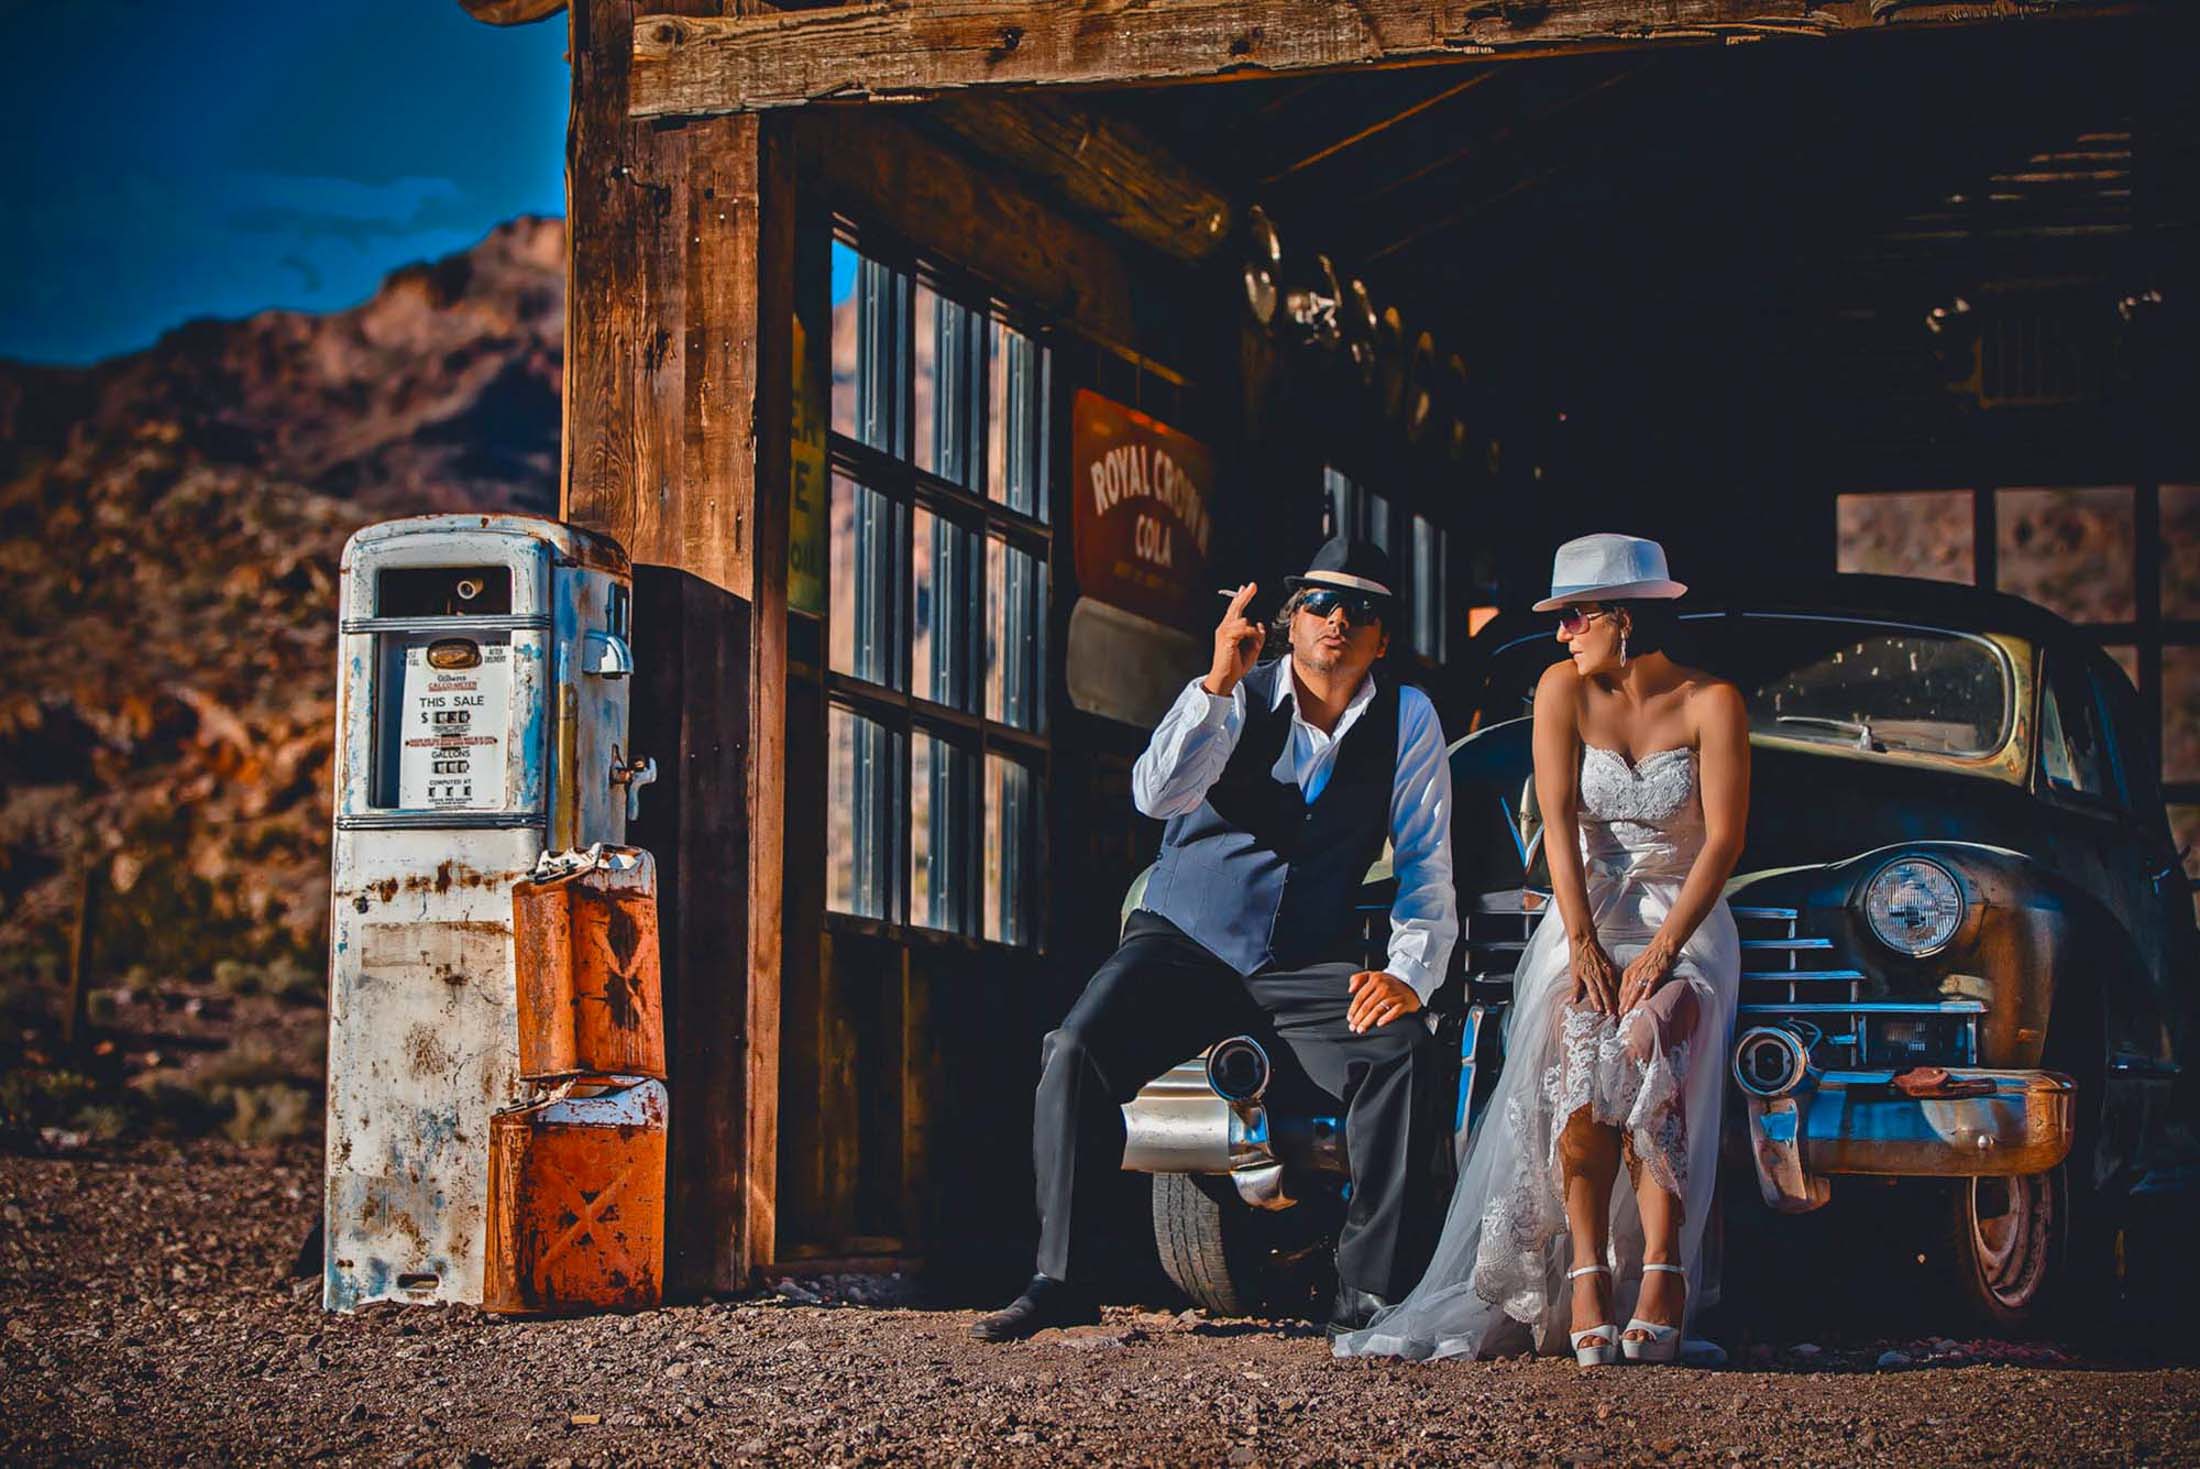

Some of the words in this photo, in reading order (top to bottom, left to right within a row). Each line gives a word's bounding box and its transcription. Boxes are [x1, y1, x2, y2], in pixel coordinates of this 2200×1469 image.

[1091, 446, 1150, 516] ROYAL
[1153, 449, 1209, 557] CROWN
[1136, 514, 1172, 568] COLA
[420, 697, 446, 708] THIS
[454, 695, 485, 706] SALE
[431, 749, 471, 759] GALLONS
